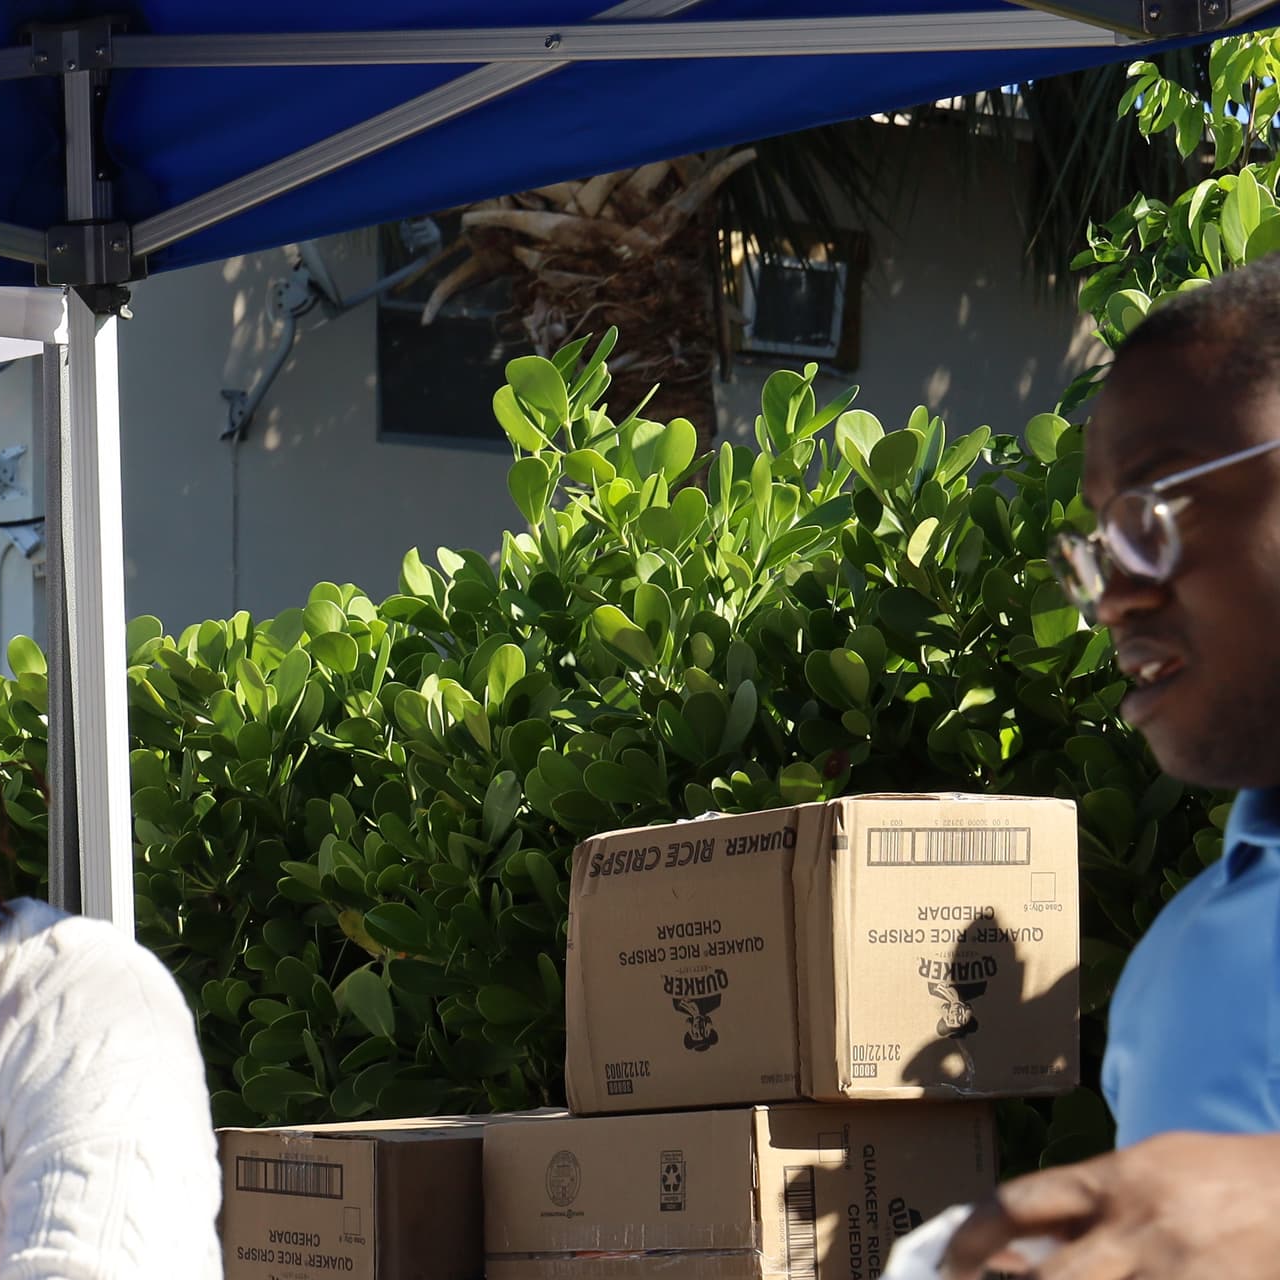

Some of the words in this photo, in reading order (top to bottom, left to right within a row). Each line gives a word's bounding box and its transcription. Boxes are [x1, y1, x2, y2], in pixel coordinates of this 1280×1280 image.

[725, 826, 797, 857] QUAKER
[589, 845, 661, 878] CRISPS
[665, 838, 715, 869] RICE
[917, 905, 995, 921] CHEDDAR
[656, 918, 721, 940] CHEDDAR
[868, 929, 925, 944] CRISPS
[931, 928, 968, 943] RICE
[619, 948, 666, 967] CRISPS
[670, 945, 700, 962] RICE
[918, 956, 998, 981] QUAKER
[663, 967, 729, 997] QUAKER
[269, 1229, 320, 1247] CHEDDAR
[237, 1246, 275, 1263] CRISPS
[277, 1251, 302, 1266] RICE
[868, 1236, 881, 1280] RICE
